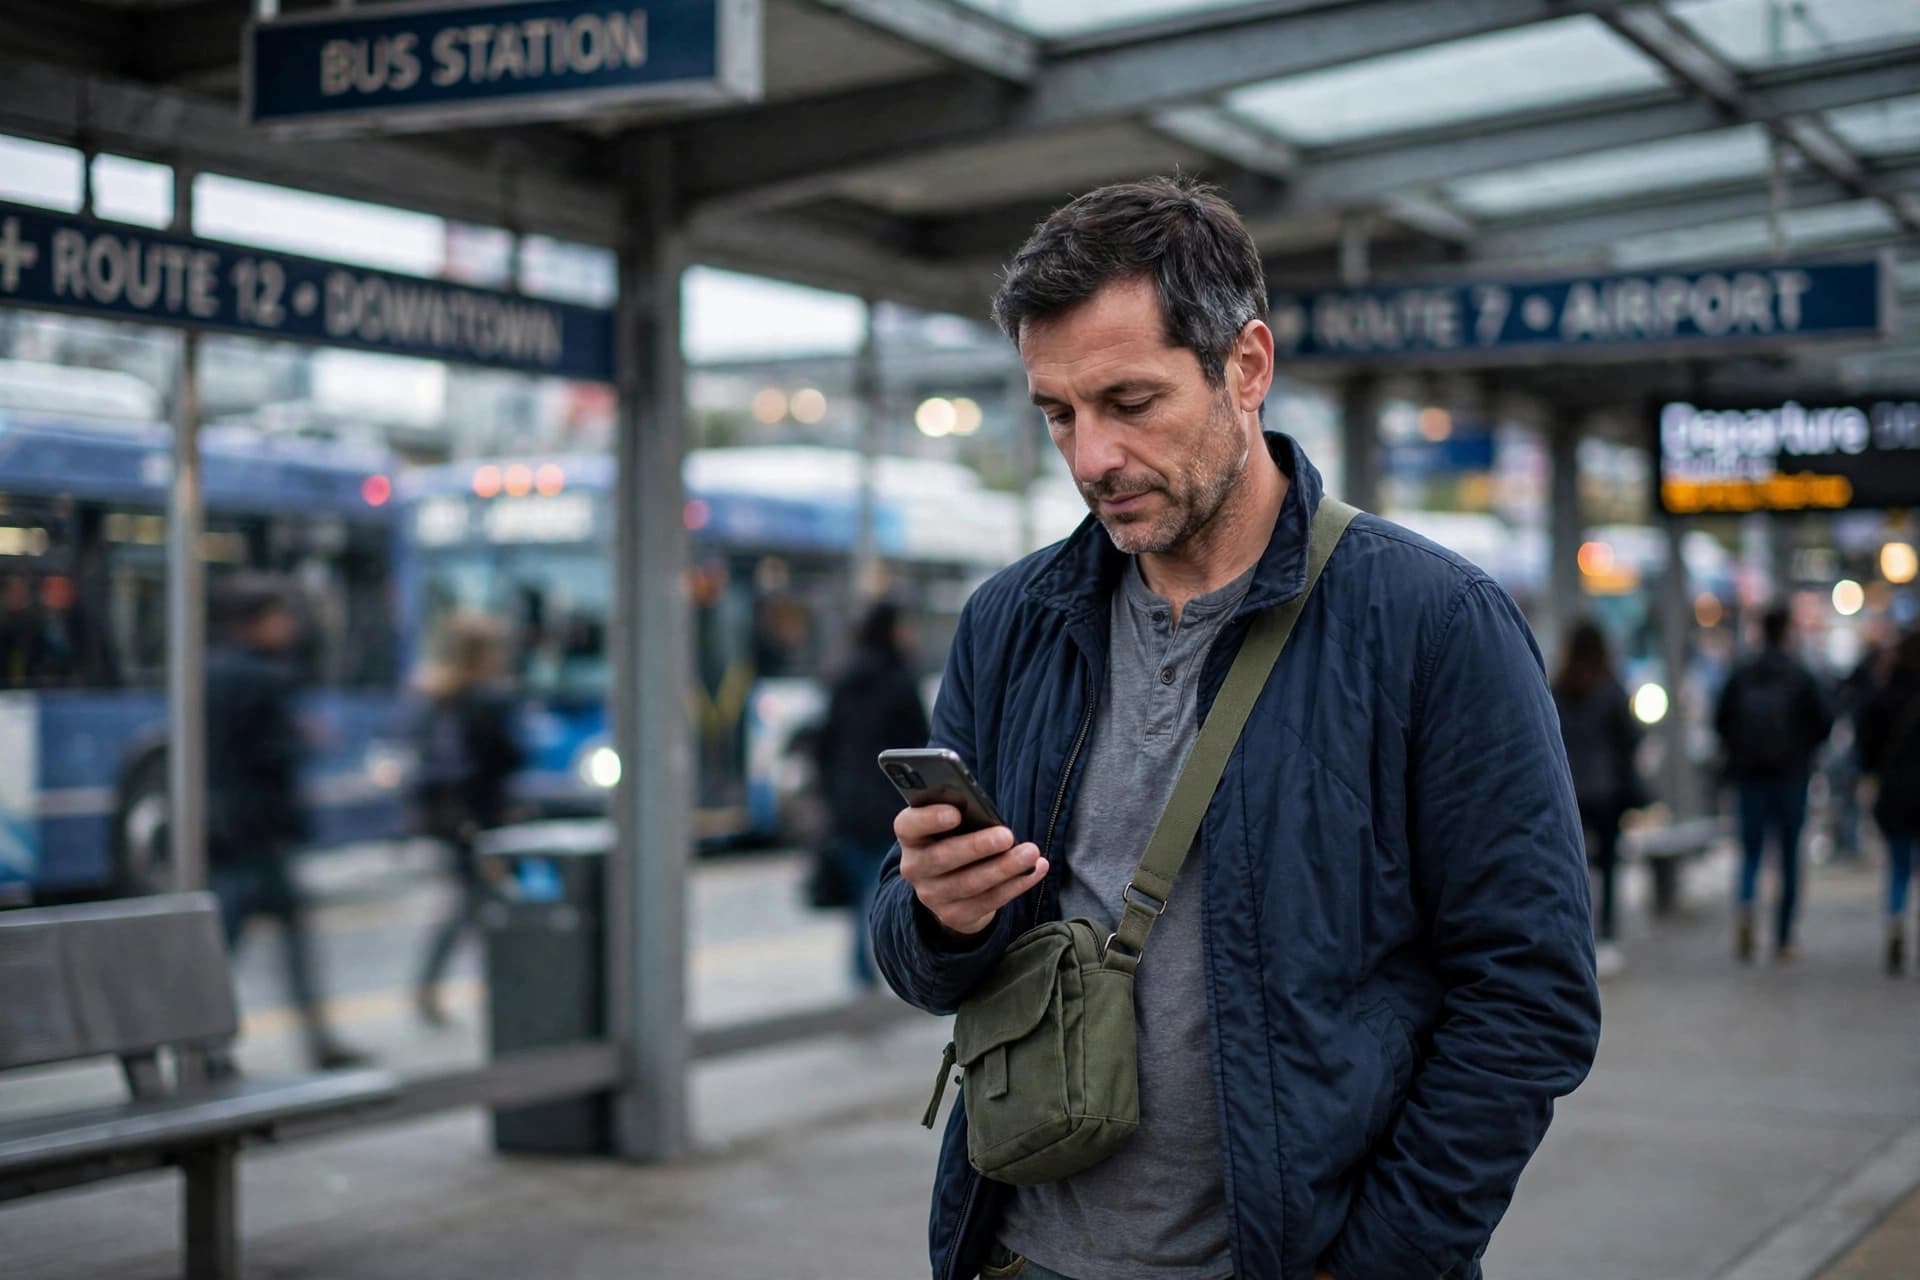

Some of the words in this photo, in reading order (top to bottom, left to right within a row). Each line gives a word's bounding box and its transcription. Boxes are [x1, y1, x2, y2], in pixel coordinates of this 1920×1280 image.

[321, 34, 421, 95] BUS
[432, 11, 648, 86] STATION
[53, 229, 220, 318] ROUTE
[232, 258, 286, 328] 12
[325, 271, 562, 363] DOWNTOWN
[1314, 290, 1457, 346] ROUTE
[1474, 286, 1509, 346] 7
[1559, 270, 1811, 339] AIRPORT
